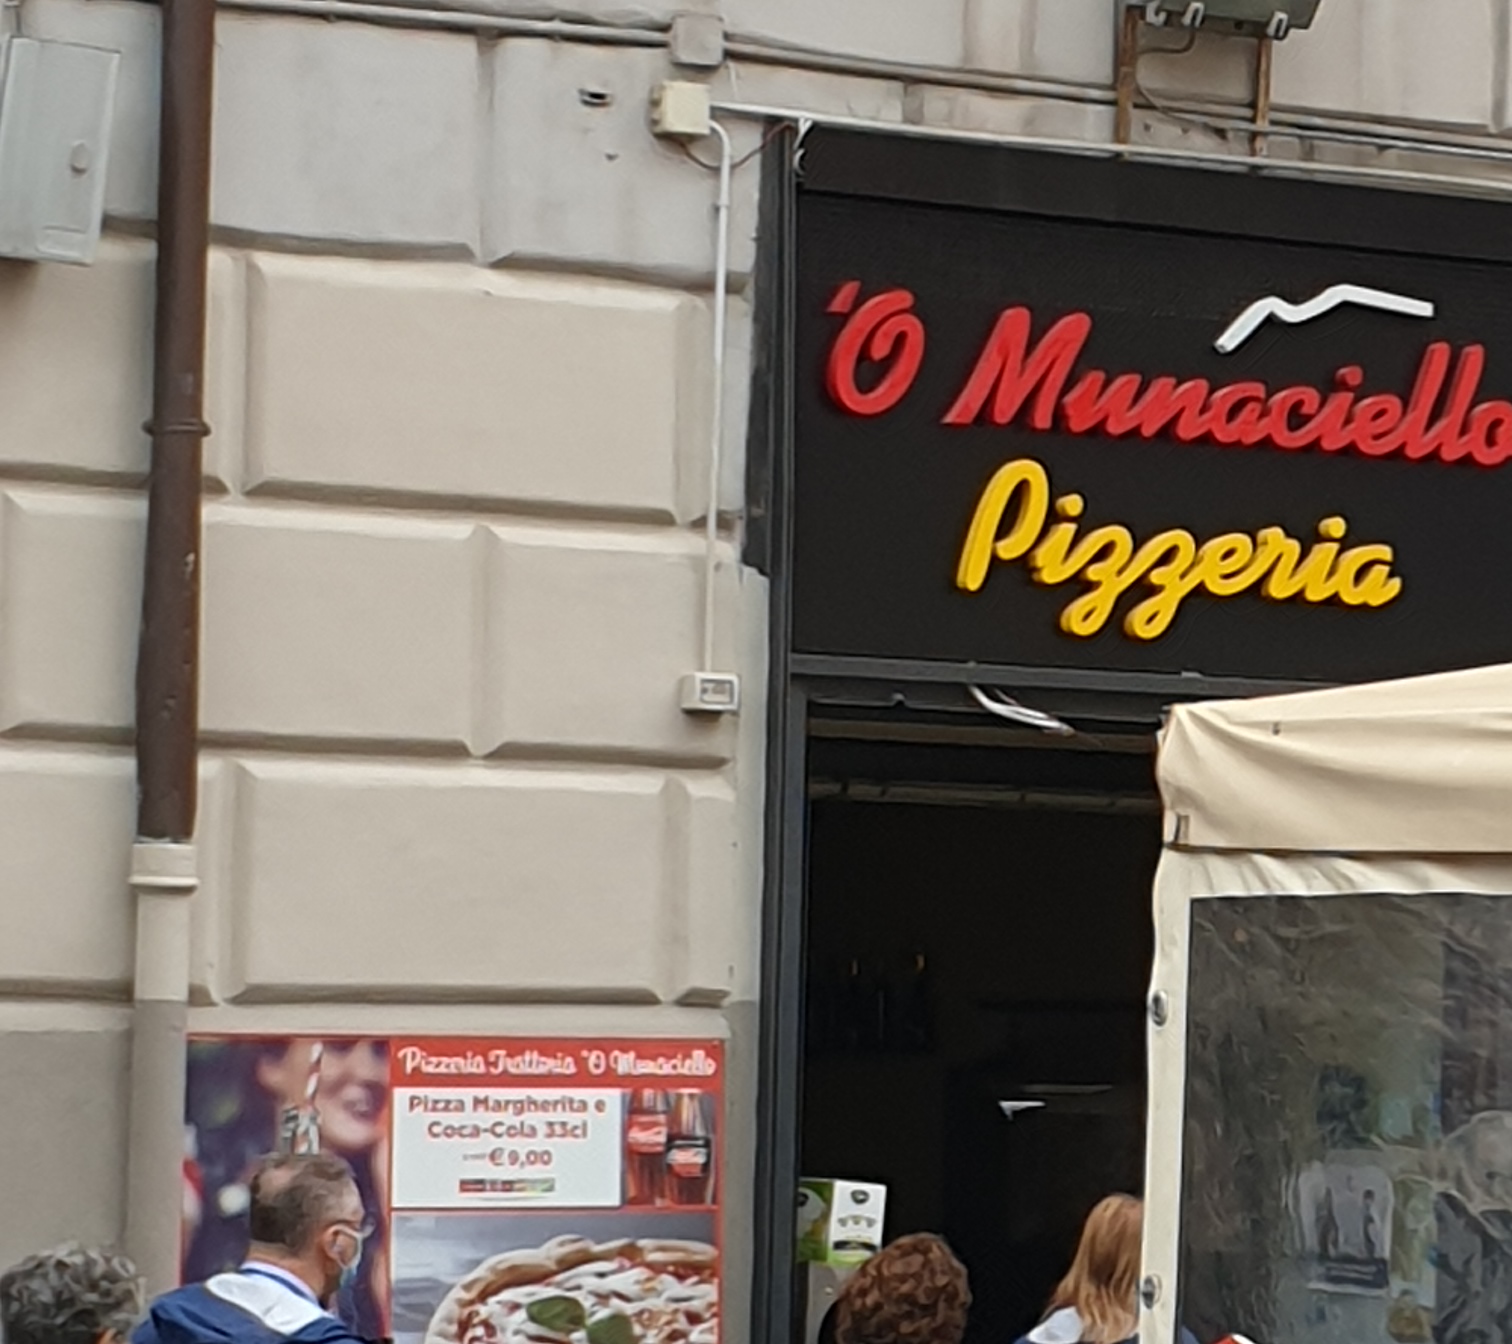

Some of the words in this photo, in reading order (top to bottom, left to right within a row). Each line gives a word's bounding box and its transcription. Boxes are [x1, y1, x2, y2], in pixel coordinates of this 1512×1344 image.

[956, 458, 1402, 641] Pizzeria
[397, 1046, 486, 1075] Pizzeria
[489, 1049, 577, 1074] Trattoria
[408, 1095, 466, 1114] Pizza
[472, 1095, 589, 1116] Margherita
[594, 1099, 606, 1114] e
[427, 1120, 538, 1140] Coca-Cola
[544, 1120, 588, 1140] 33cl
